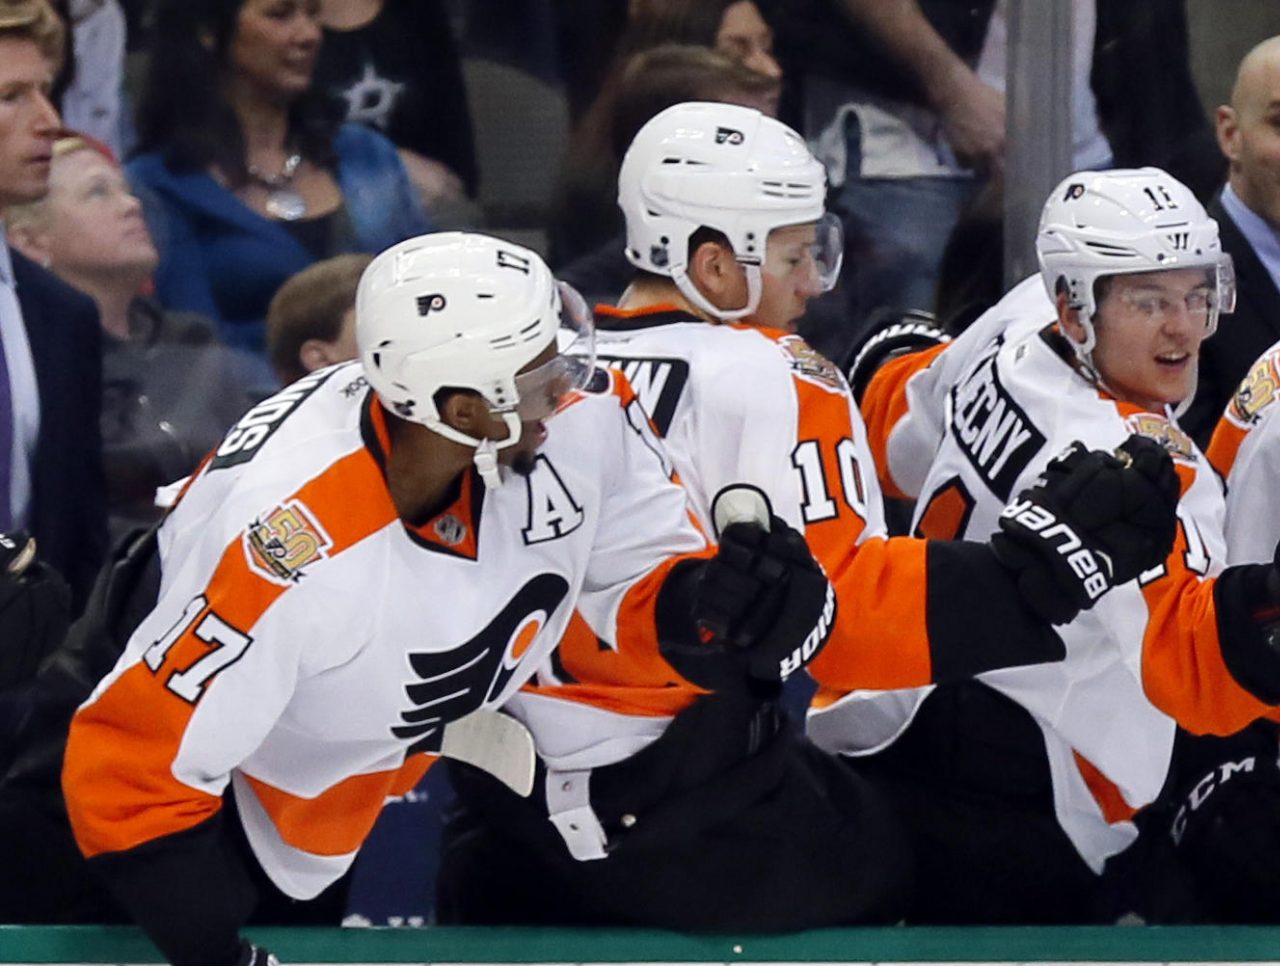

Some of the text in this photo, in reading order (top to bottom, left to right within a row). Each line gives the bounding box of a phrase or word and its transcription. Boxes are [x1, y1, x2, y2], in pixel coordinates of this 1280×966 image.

[521, 456, 585, 546] A
[790, 437, 868, 524] 10
[142, 593, 254, 706] 17
[1170, 756, 1256, 847] CCM
